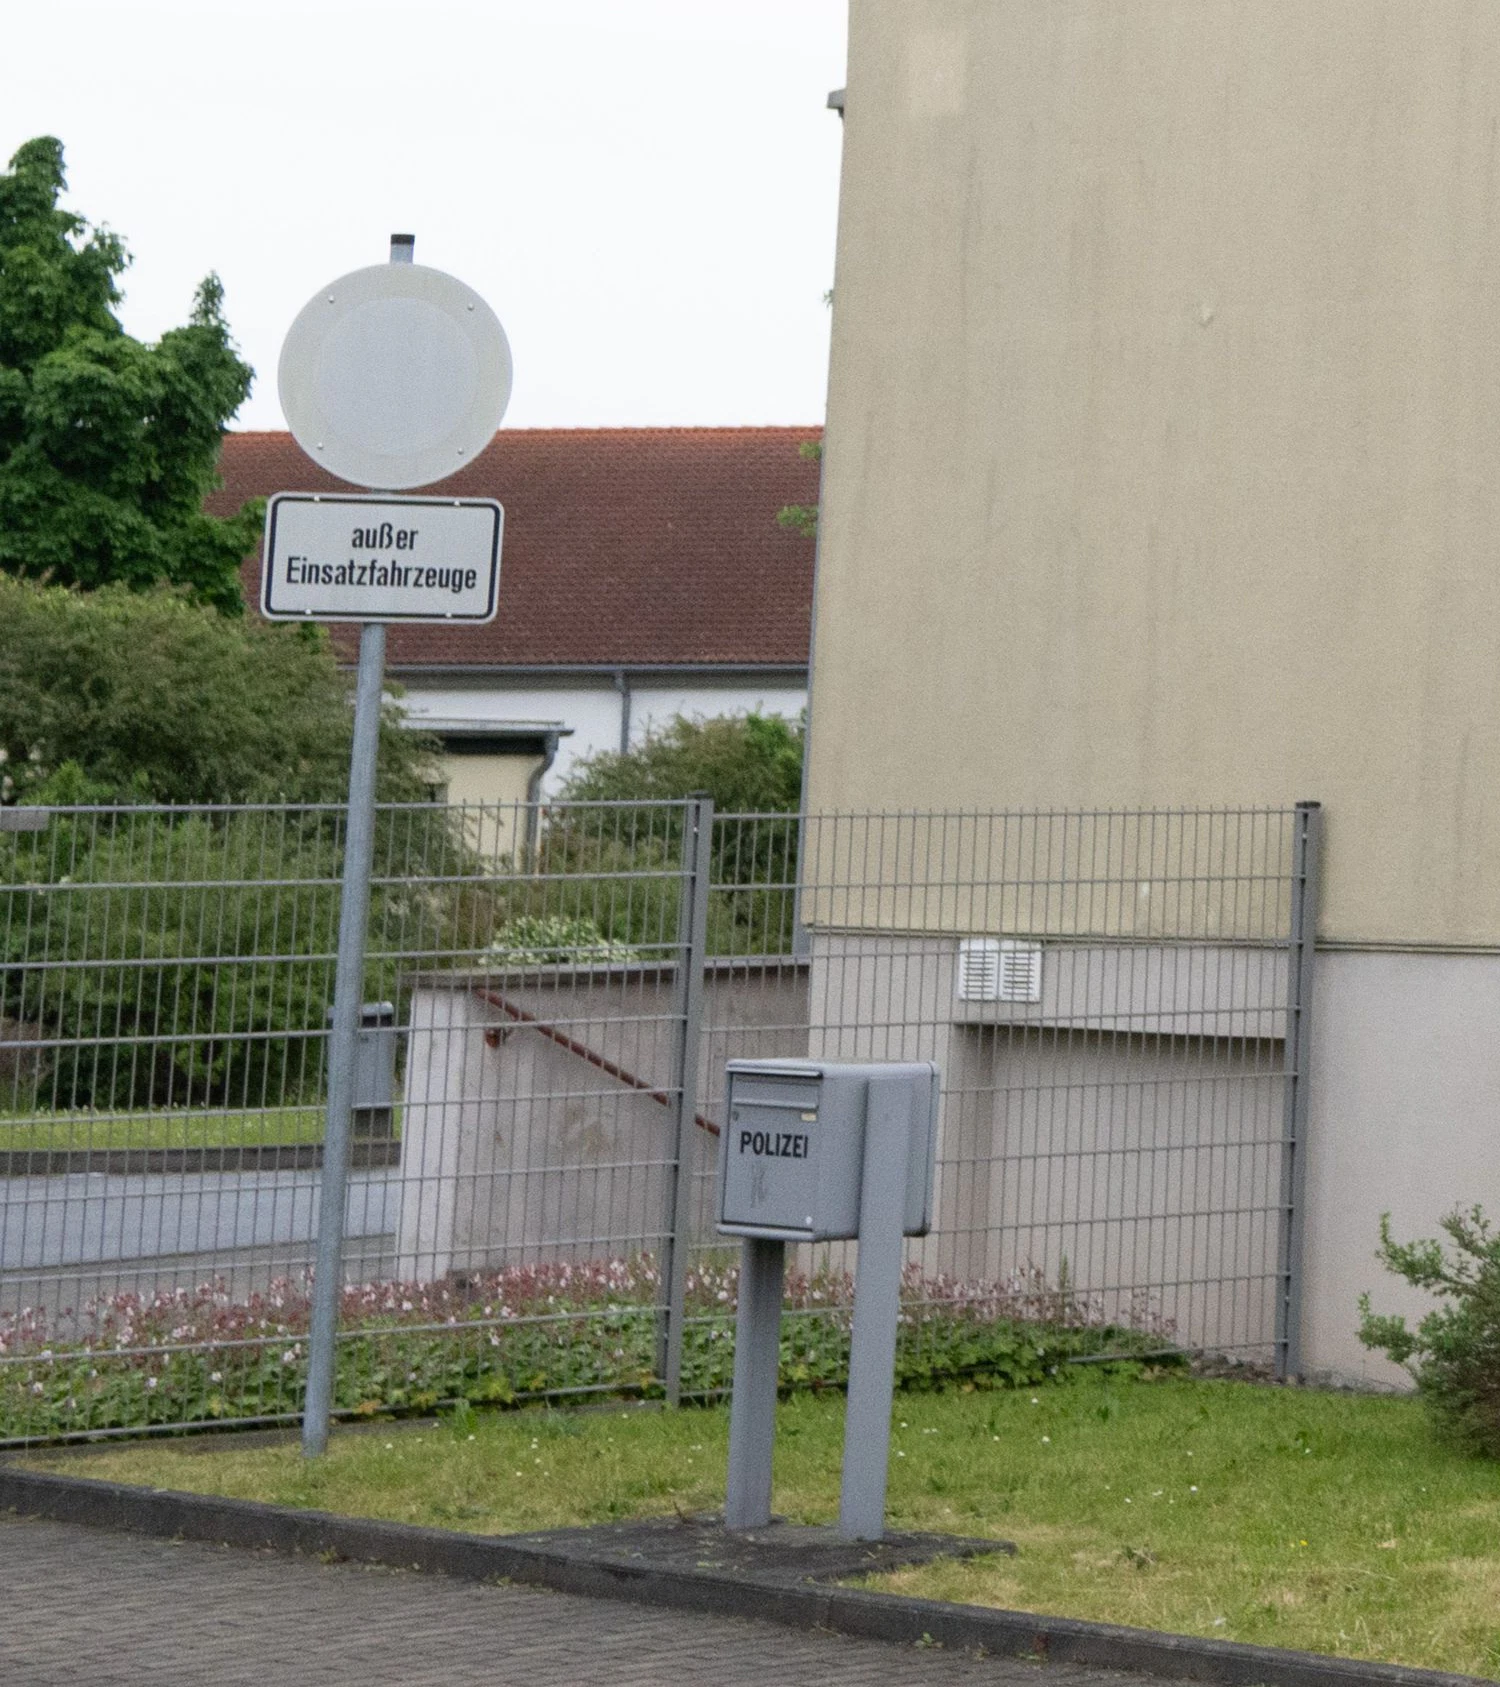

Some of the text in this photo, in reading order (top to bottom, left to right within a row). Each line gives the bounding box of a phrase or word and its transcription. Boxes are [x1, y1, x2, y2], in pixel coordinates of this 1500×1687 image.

[351, 522, 418, 550] außer
[286, 555, 477, 593] Einsatzfahrzeuge
[740, 1131, 808, 1158] POLIZEI
